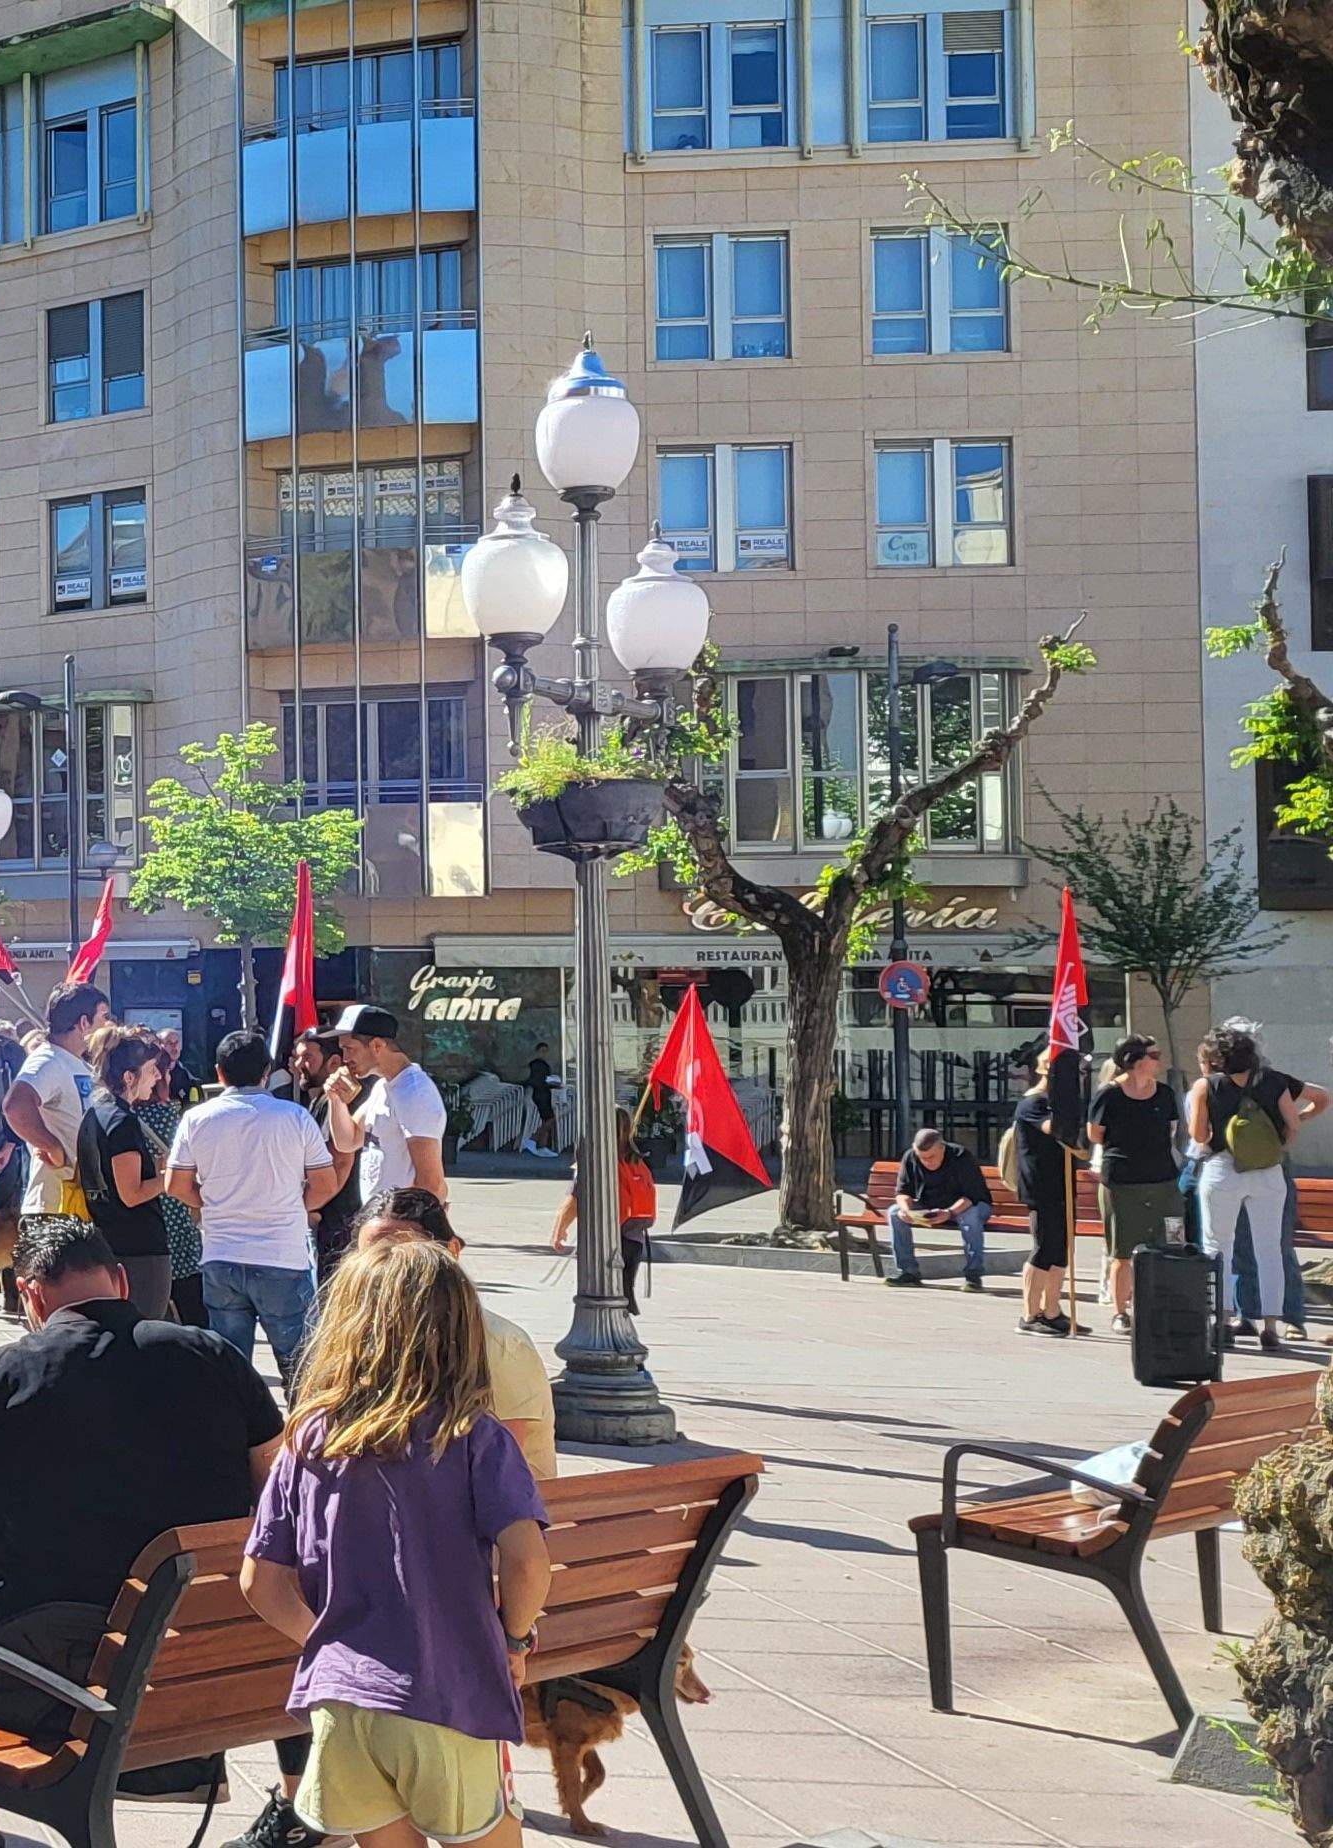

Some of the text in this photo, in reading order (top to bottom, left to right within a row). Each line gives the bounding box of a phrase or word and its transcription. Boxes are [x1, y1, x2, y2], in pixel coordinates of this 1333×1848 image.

[752, 538, 784, 546] REALE
[408, 964, 497, 1011] Granja
[424, 997, 522, 1021] ANITA
